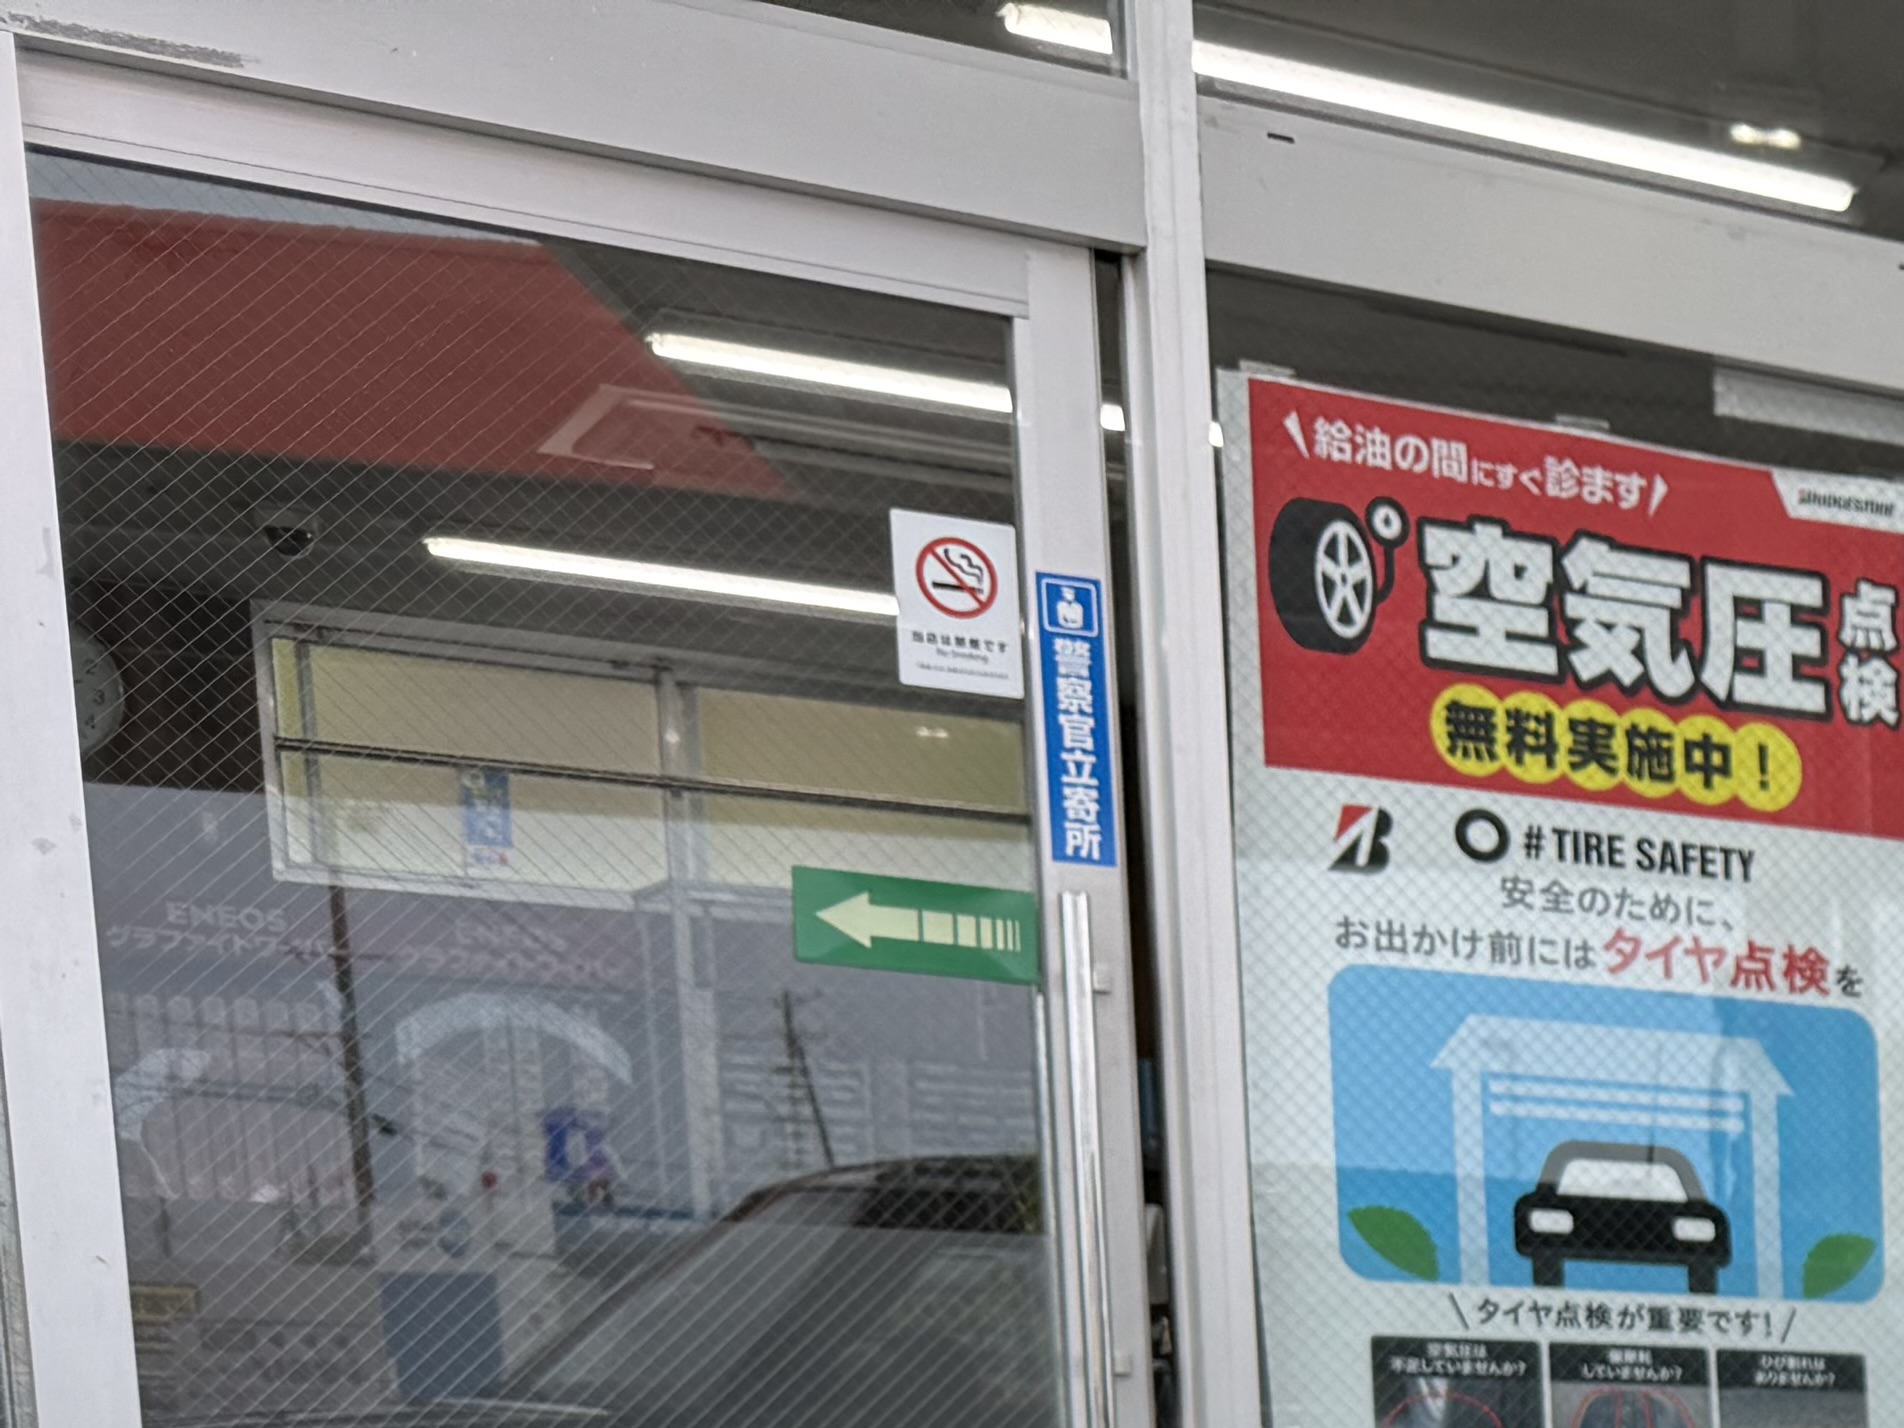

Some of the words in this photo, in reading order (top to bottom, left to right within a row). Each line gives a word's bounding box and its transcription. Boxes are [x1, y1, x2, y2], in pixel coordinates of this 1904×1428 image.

[1313, 416, 1648, 510] 給油の間にすぐ診ます
[1420, 518, 1832, 720] 空気圧
[1838, 578, 1899, 727] 点検
[1054, 637, 1103, 861] 警察官立寄所
[1636, 832, 1756, 884] SAFETY
[1334, 915, 1864, 999] お出かけ前にはタイヤ点検を
